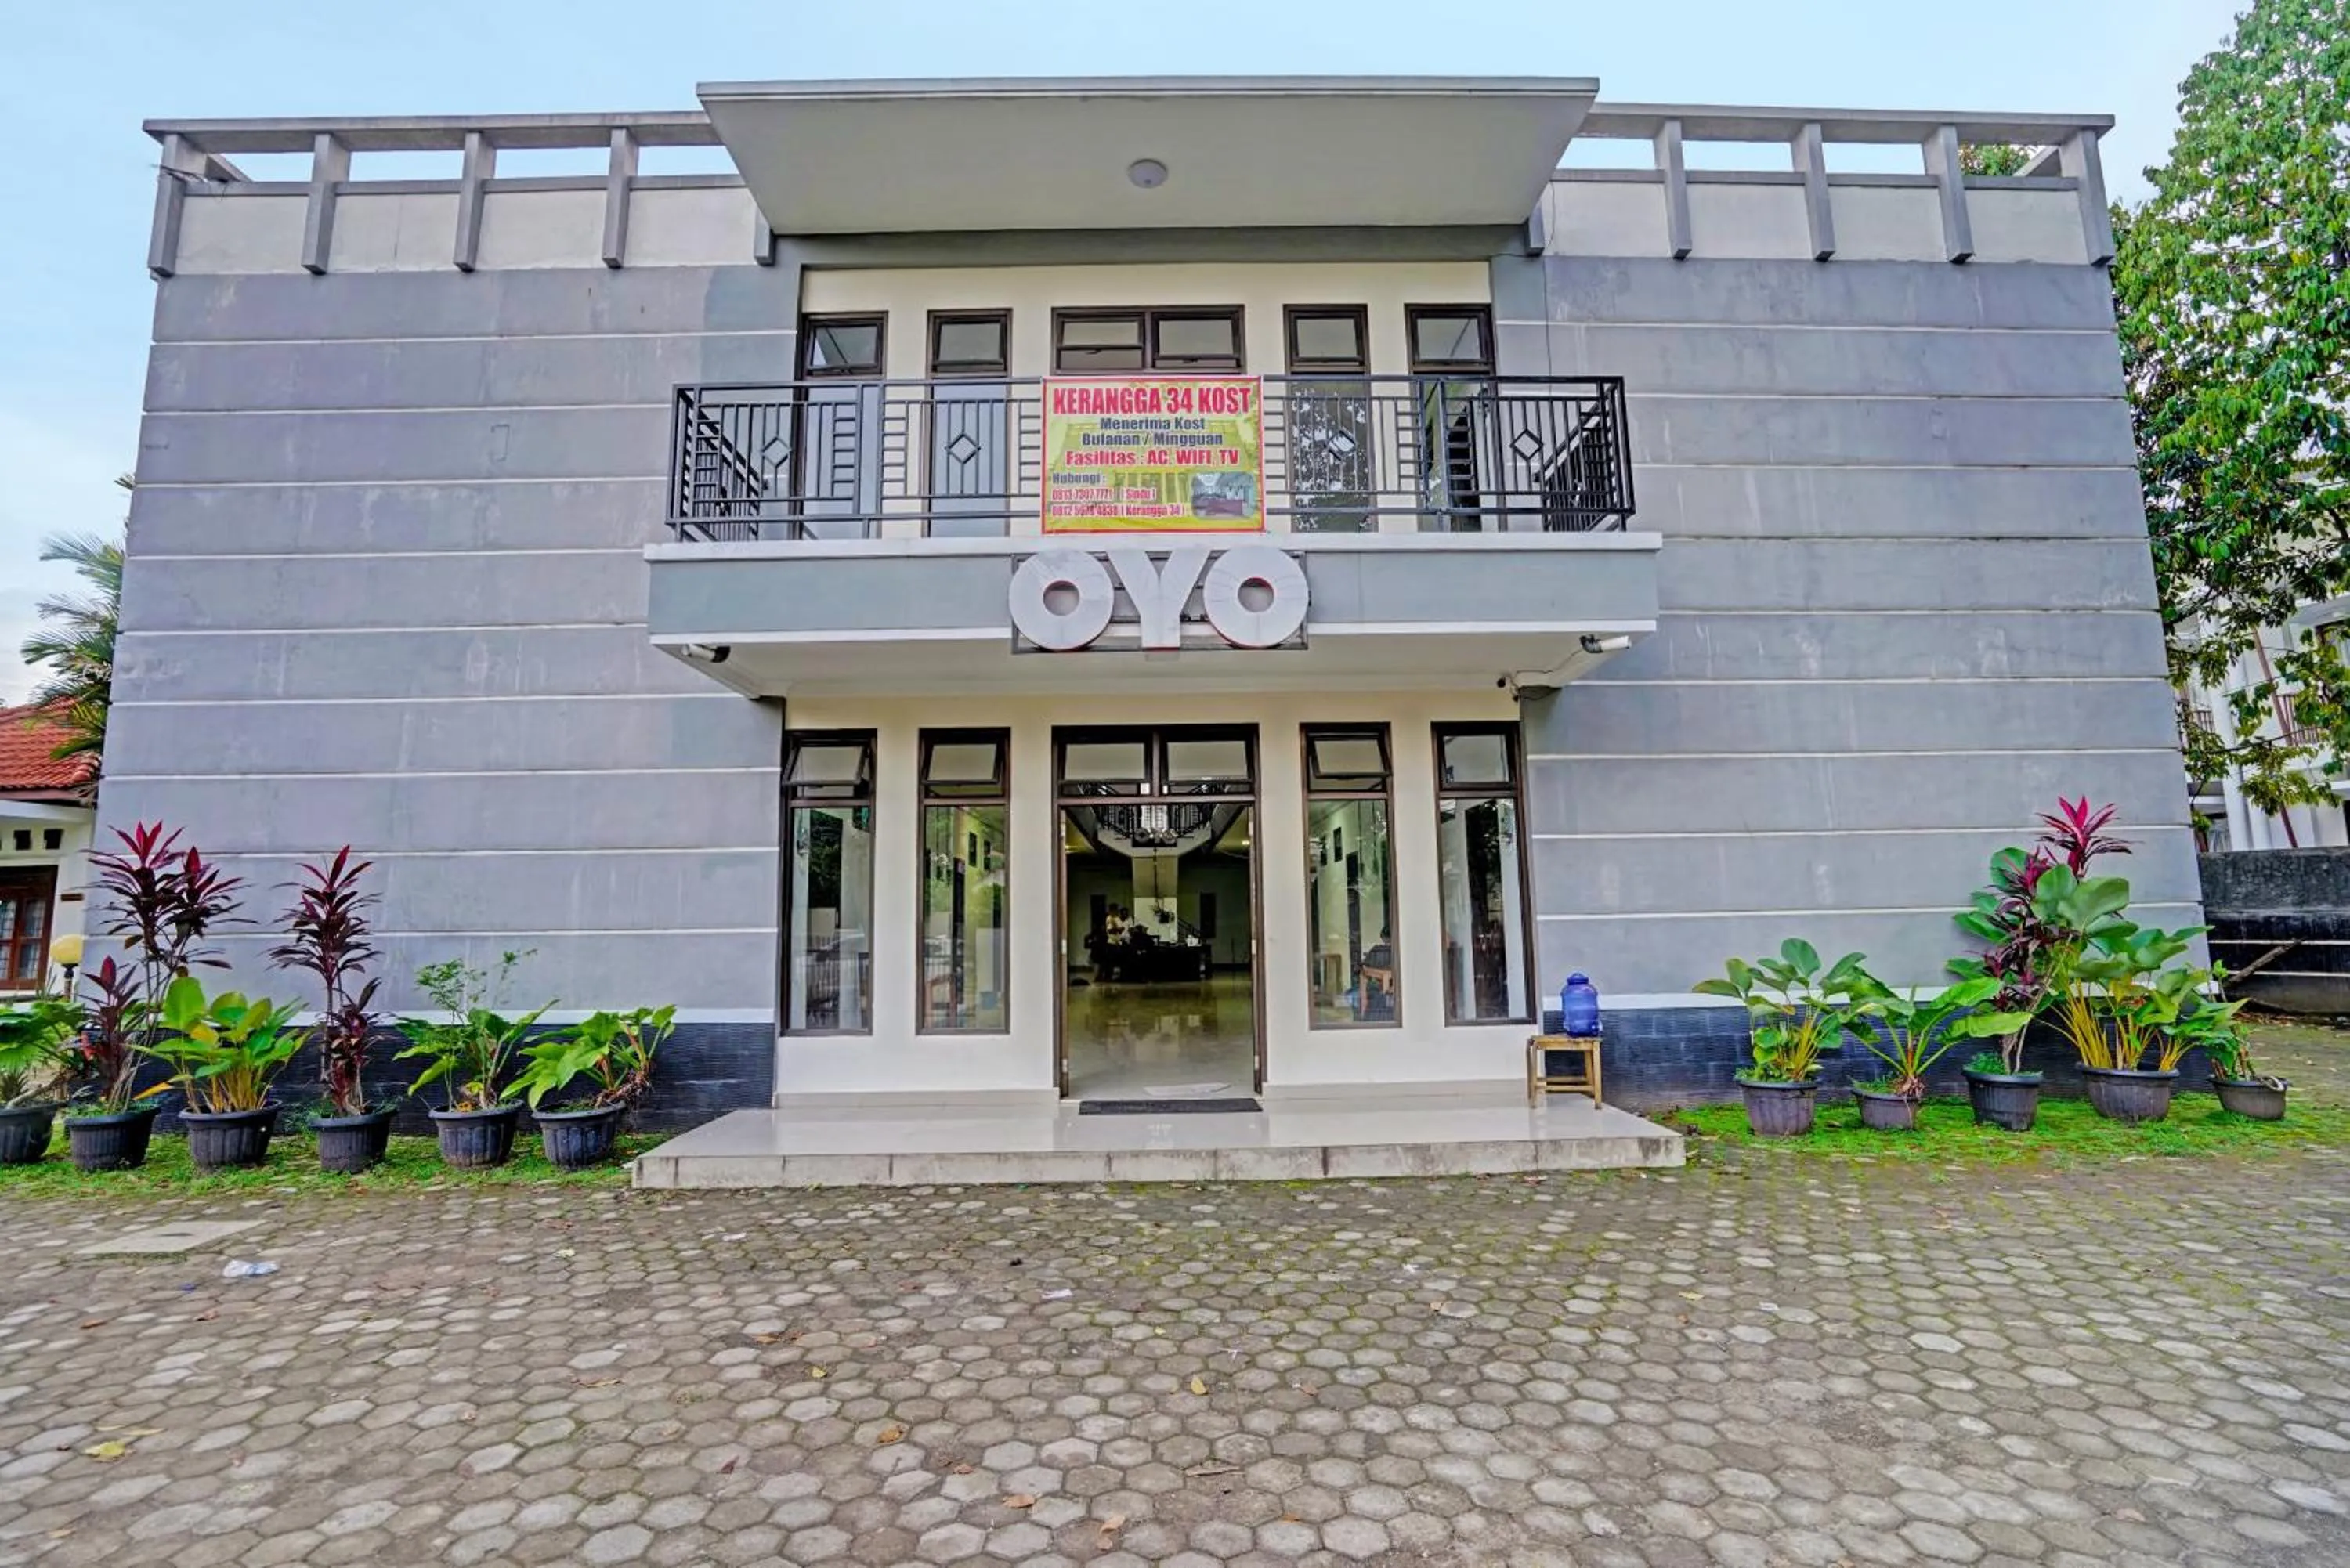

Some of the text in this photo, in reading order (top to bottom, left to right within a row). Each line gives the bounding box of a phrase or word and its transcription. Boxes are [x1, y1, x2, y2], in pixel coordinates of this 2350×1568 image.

[1053, 387, 1251, 414] KERANGGA 34 KOST
[1100, 417, 1206, 430] Menerima Kost
[1082, 433, 1140, 446] Bulanan
[1153, 433, 1223, 447] Mingguan
[1065, 450, 1136, 465] Fasilitas
[1219, 450, 1239, 464] TV
[1052, 472, 1101, 485] Hubungi
[1009, 548, 1310, 652] OYO
